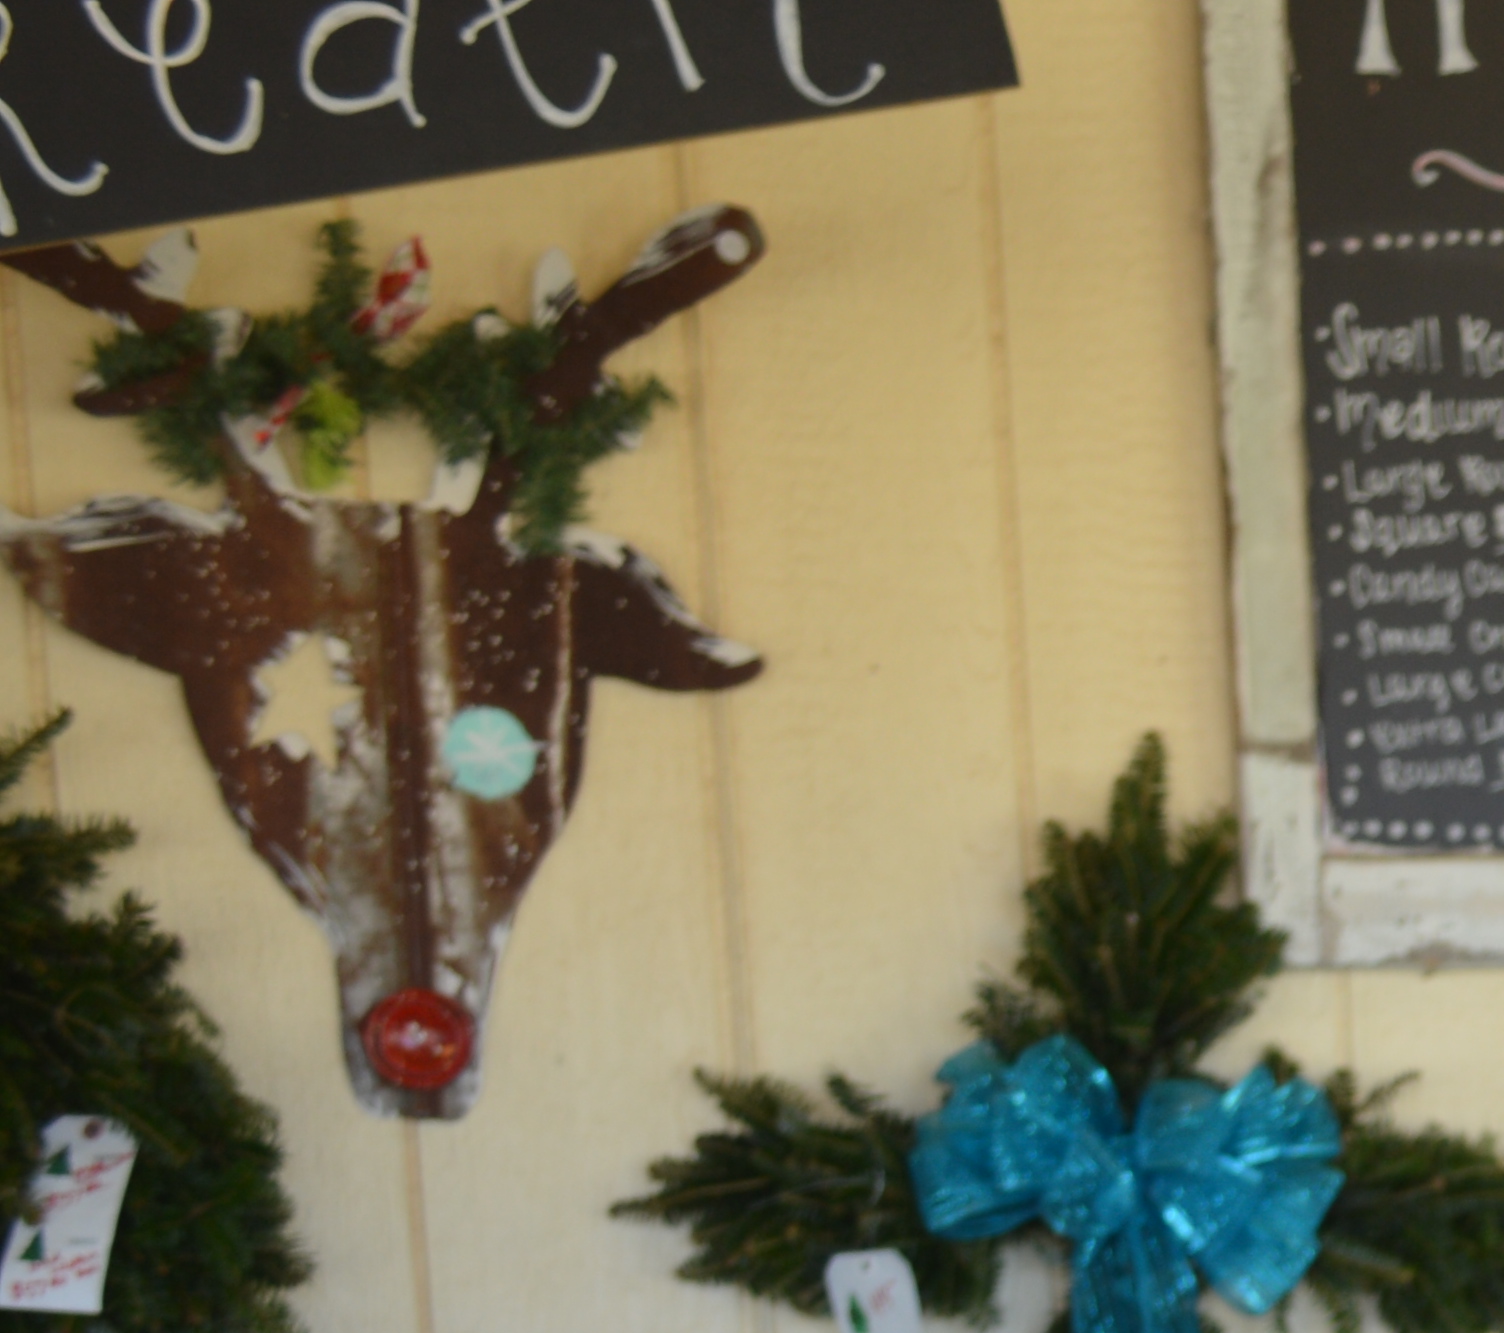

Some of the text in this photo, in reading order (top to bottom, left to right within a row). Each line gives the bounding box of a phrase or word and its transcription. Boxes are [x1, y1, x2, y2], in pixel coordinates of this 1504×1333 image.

[1326, 302, 1442, 380] Small
[1342, 458, 1452, 513] Large
[1350, 507, 1489, 558] Square
[1348, 562, 1464, 620] Candy
[1368, 668, 1479, 713] Large
